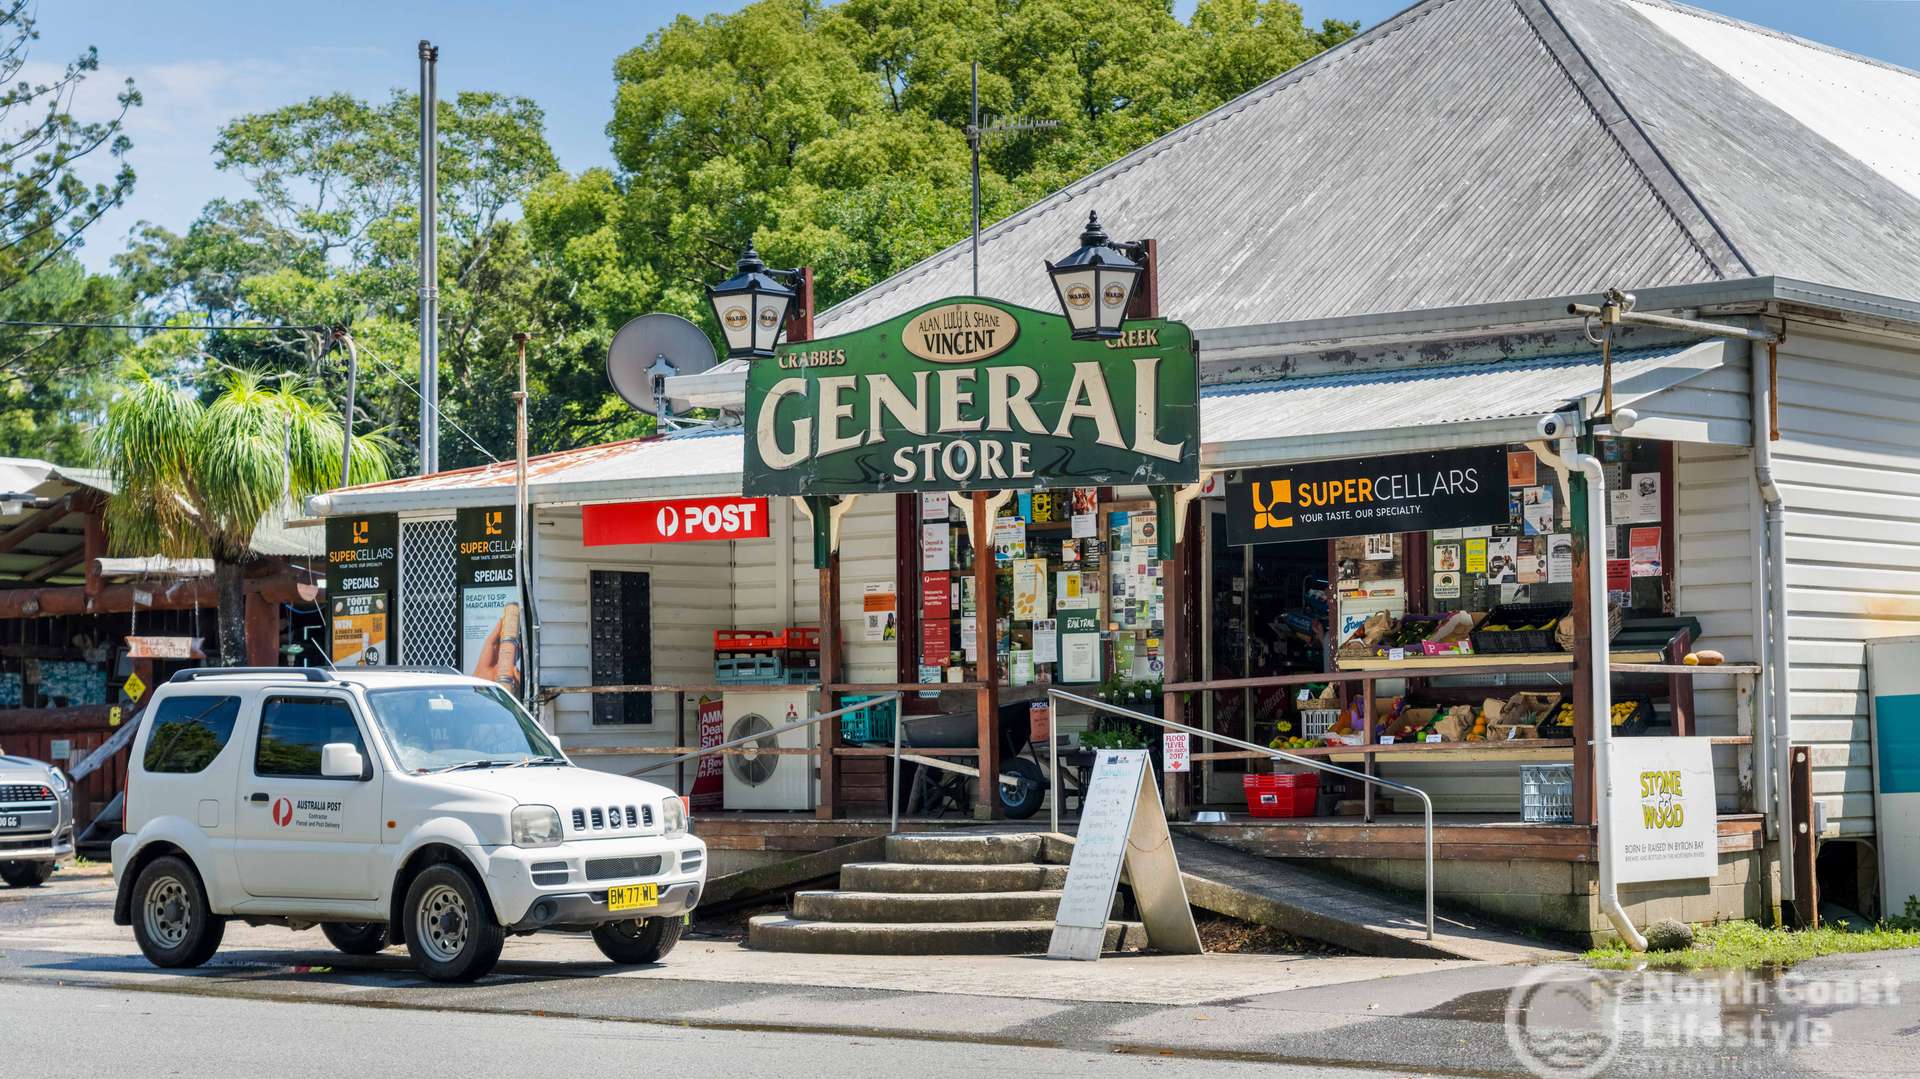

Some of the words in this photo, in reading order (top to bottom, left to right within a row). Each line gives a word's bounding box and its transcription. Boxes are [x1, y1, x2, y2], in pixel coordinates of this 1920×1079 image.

[1068, 292, 1091, 300] WARDS
[919, 316, 941, 331] ALAN,
[943, 312, 962, 329] LULU
[965, 312, 971, 328] &
[974, 312, 1000, 328] SHANE
[924, 329, 995, 355] VINCENT
[778, 349, 847, 369] CRABBES
[757, 358, 1185, 471] GENERAL
[893, 439, 1036, 483] STORE
[1298, 468, 1479, 508] SUPERCELLARS
[684, 504, 757, 534] POST
[1300, 512, 1323, 523] YOUR
[1326, 510, 1353, 521] TASTE.
[1355, 509, 1374, 519] OUR
[1376, 505, 1423, 517] SPECIALTY.
[329, 547, 394, 563] SUPERCELLARS
[342, 576, 380, 590] SPECIALS
[474, 568, 513, 583] SPECIALS
[465, 594, 486, 602] READY
[465, 601, 505, 609] MARGARITAS
[350, 605, 369, 615] SALE
[1640, 770, 1682, 798] STONE
[297, 800, 326, 810] AUSTRALIA
[327, 802, 342, 811] POST
[1642, 804, 1684, 829] WOOD
[1625, 844, 1640, 854] BORN
[1648, 842, 1667, 852] RAISED
[1668, 842, 1674, 851] IN
[1675, 841, 1693, 851] BYRON
[1694, 840, 1704, 849] BAY
